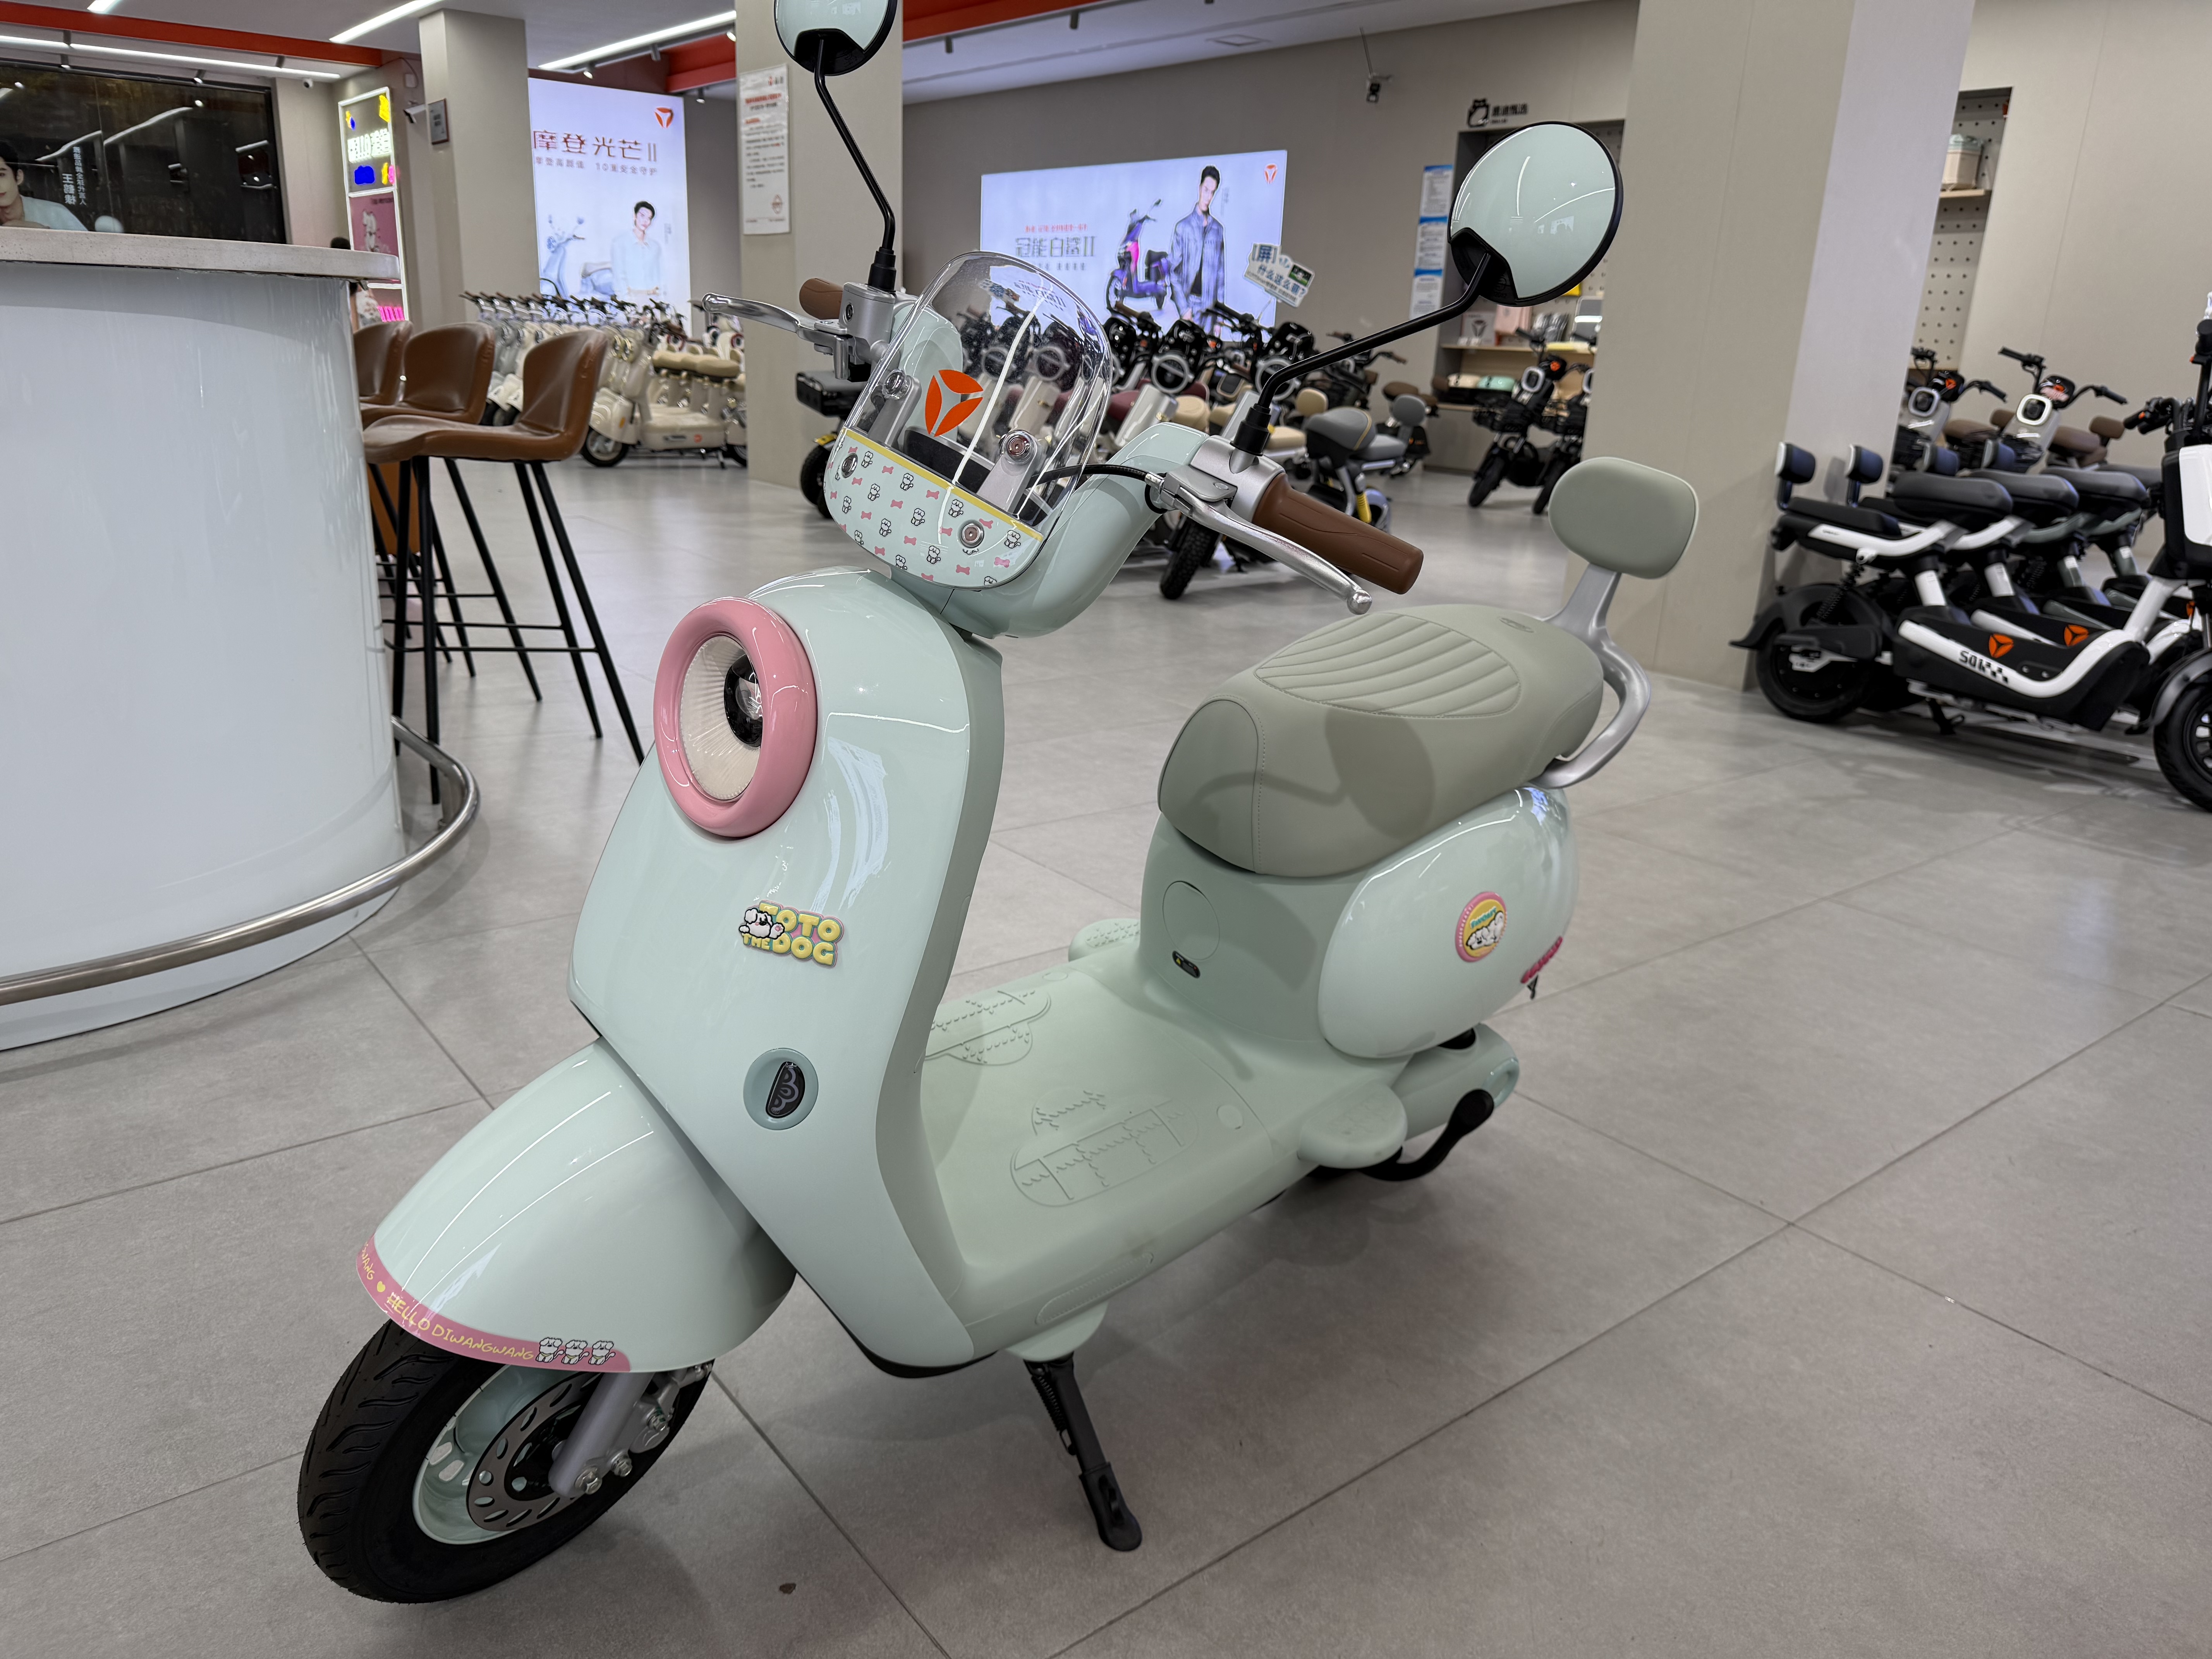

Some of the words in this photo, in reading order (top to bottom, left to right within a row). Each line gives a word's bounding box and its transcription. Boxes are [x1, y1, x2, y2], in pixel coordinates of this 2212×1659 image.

[772, 932, 834, 965] DOG
[386, 1292, 430, 1331] HELLO
[431, 1324, 534, 1360] DIWANGWANG
